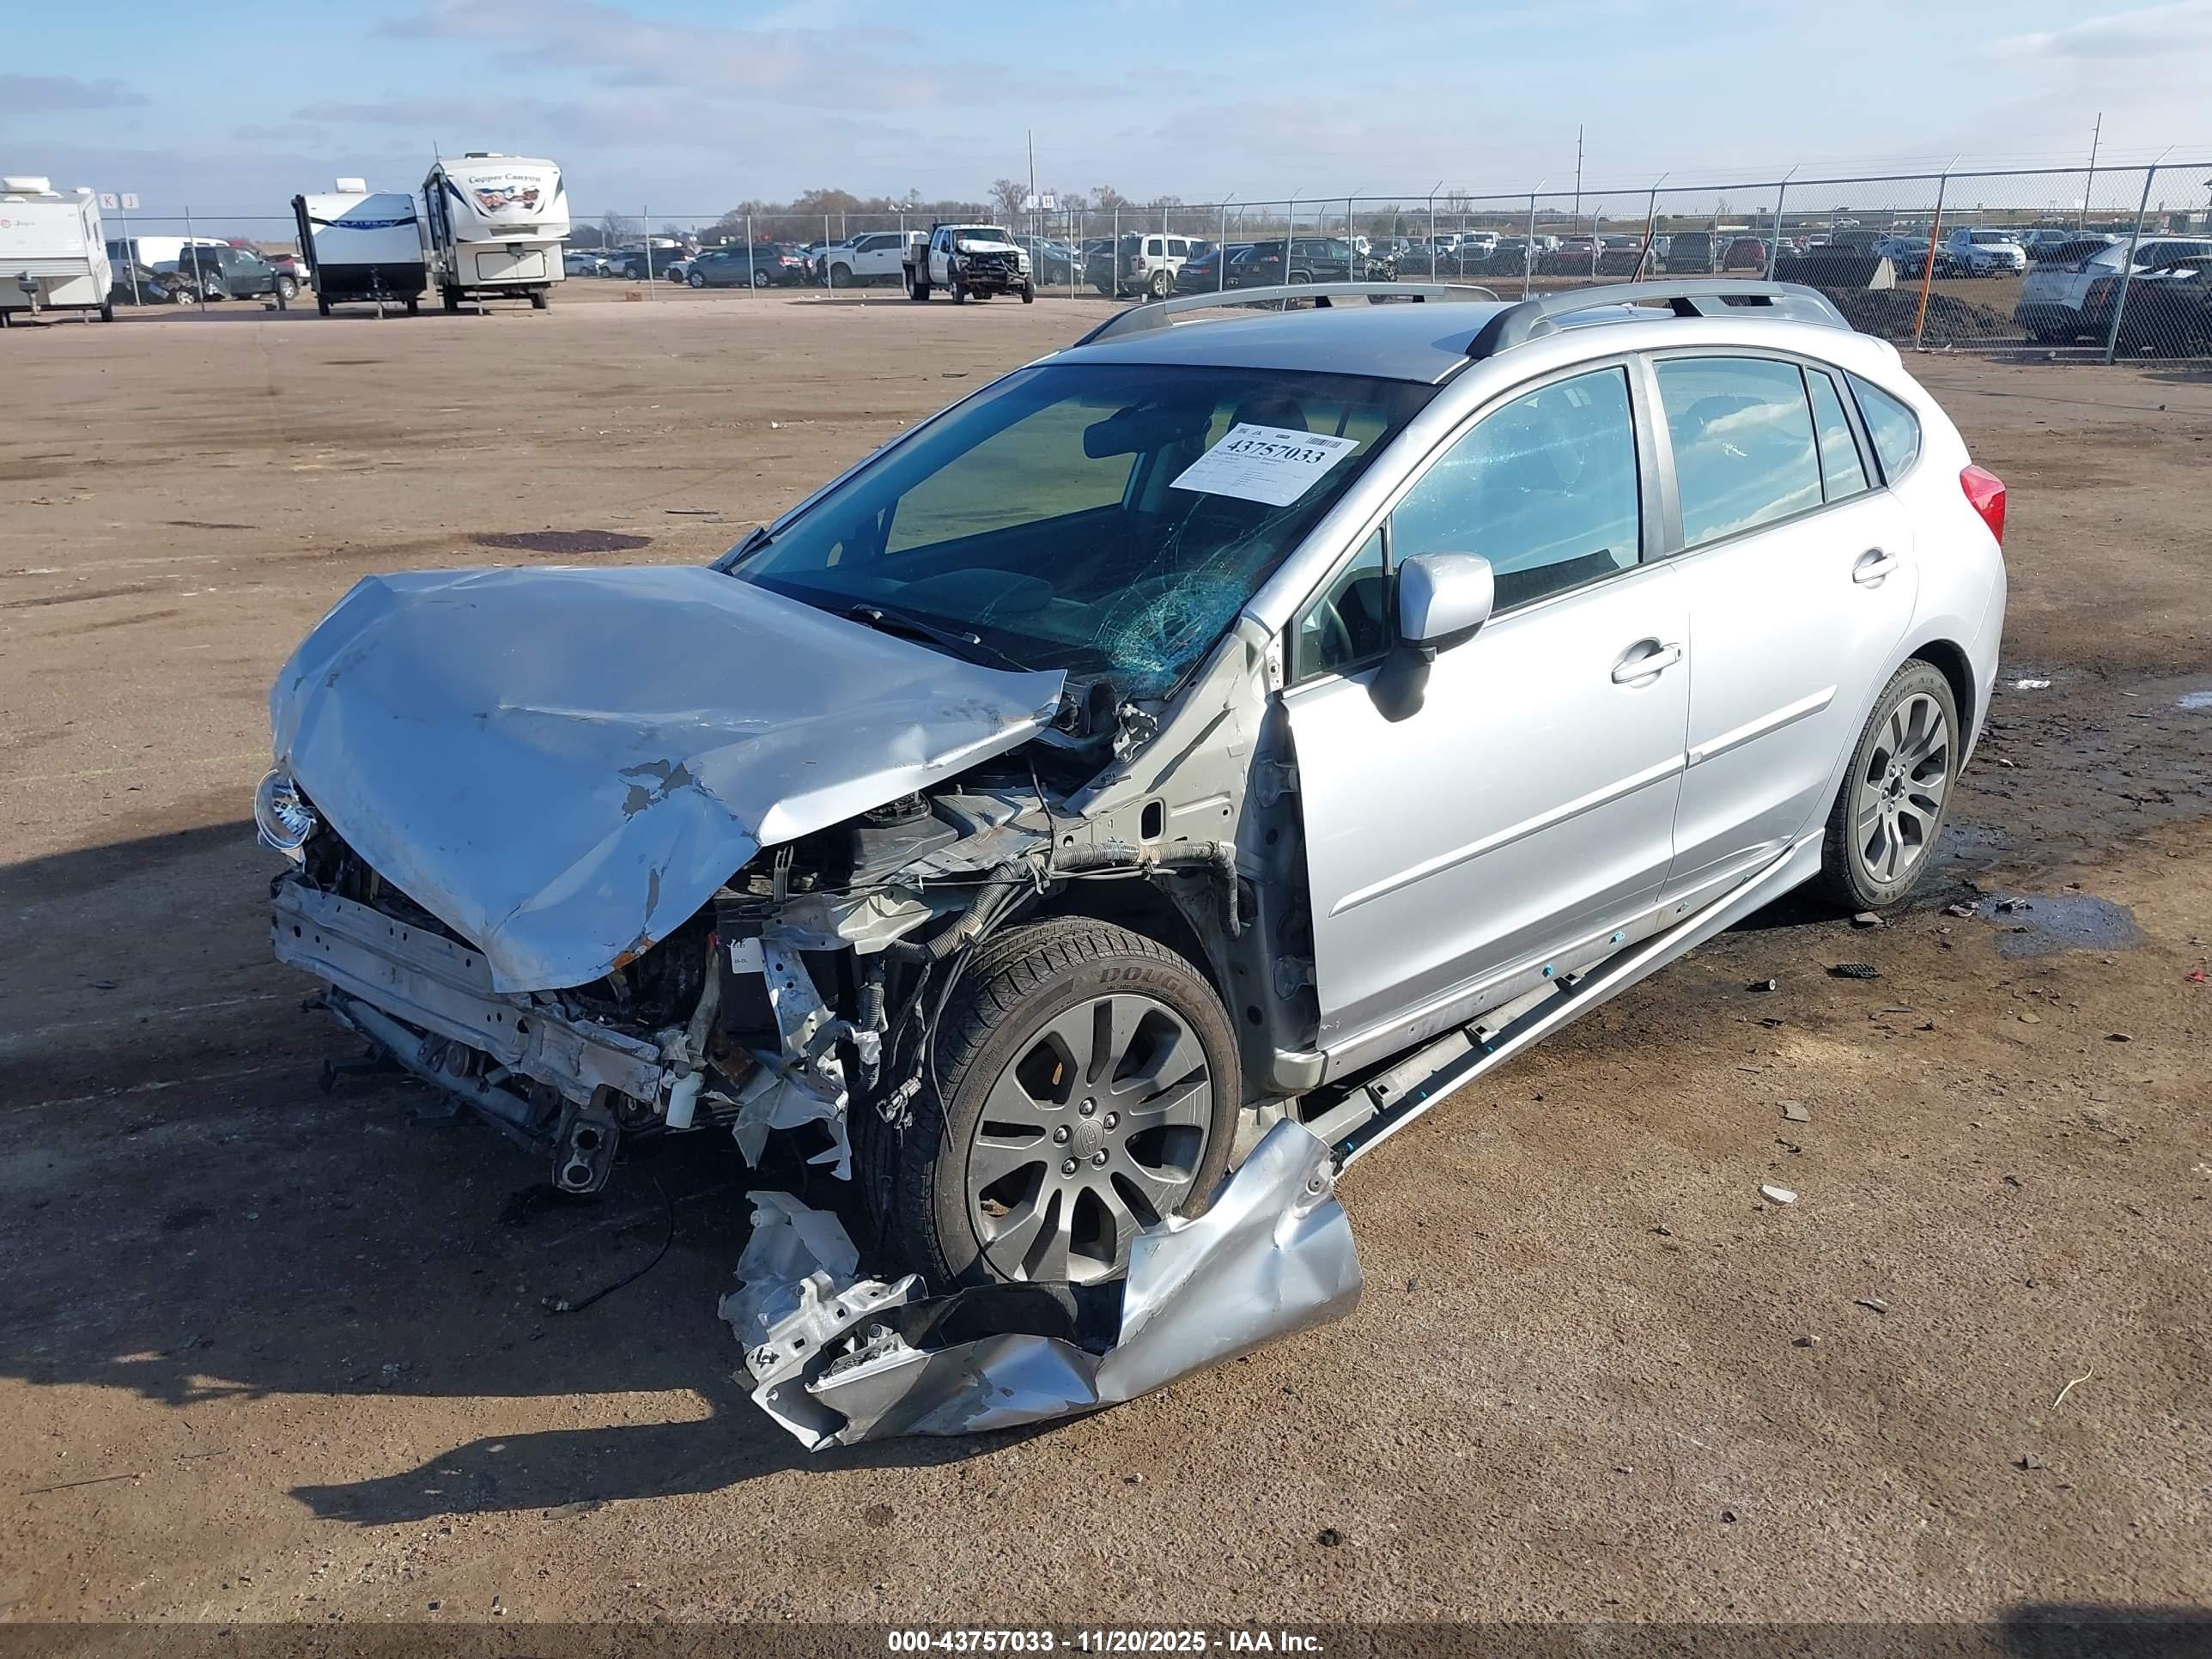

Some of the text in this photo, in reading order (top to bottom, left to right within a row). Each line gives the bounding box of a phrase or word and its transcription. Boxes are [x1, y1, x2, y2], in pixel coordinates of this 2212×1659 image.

[468, 173, 541, 184] Copper Canyon
[103, 195, 113, 207] K
[1226, 439, 1327, 464] 43757033
[1099, 966, 1218, 1041] DOUGLA
